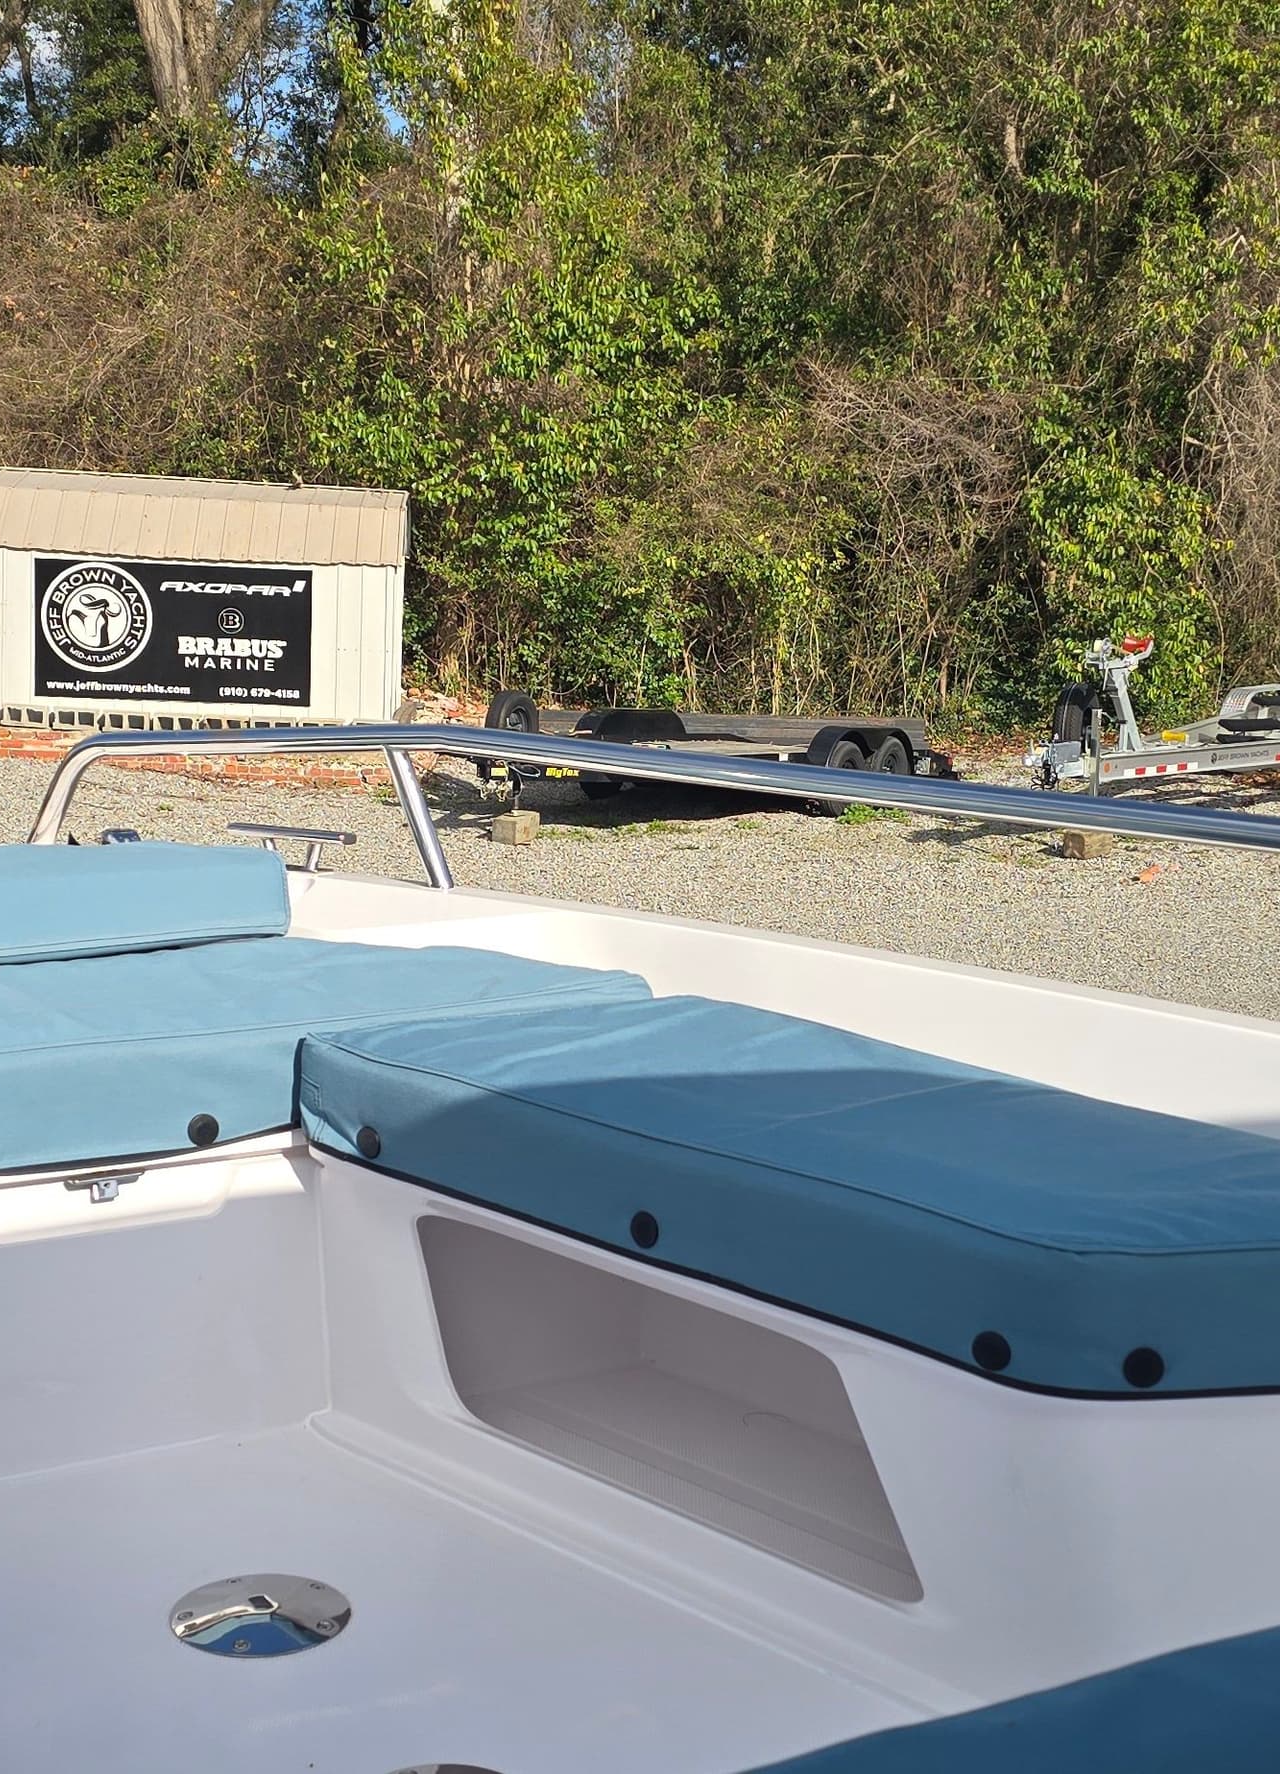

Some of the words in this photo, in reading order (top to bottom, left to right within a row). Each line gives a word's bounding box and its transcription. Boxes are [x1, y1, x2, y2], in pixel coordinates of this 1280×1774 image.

[52, 569, 116, 604] BROWN
[160, 581, 292, 597] AXOPAR
[120, 579, 145, 649] YACHTS
[49, 607, 72, 646] JEFF
[69, 647, 126, 663] MID-ATLANTIC
[177, 636, 287, 658] BRABUS
[184, 656, 275, 672] MARINE
[46, 680, 192, 695] www.jeffbrownyachts.com
[218, 686, 248, 698] (910)
